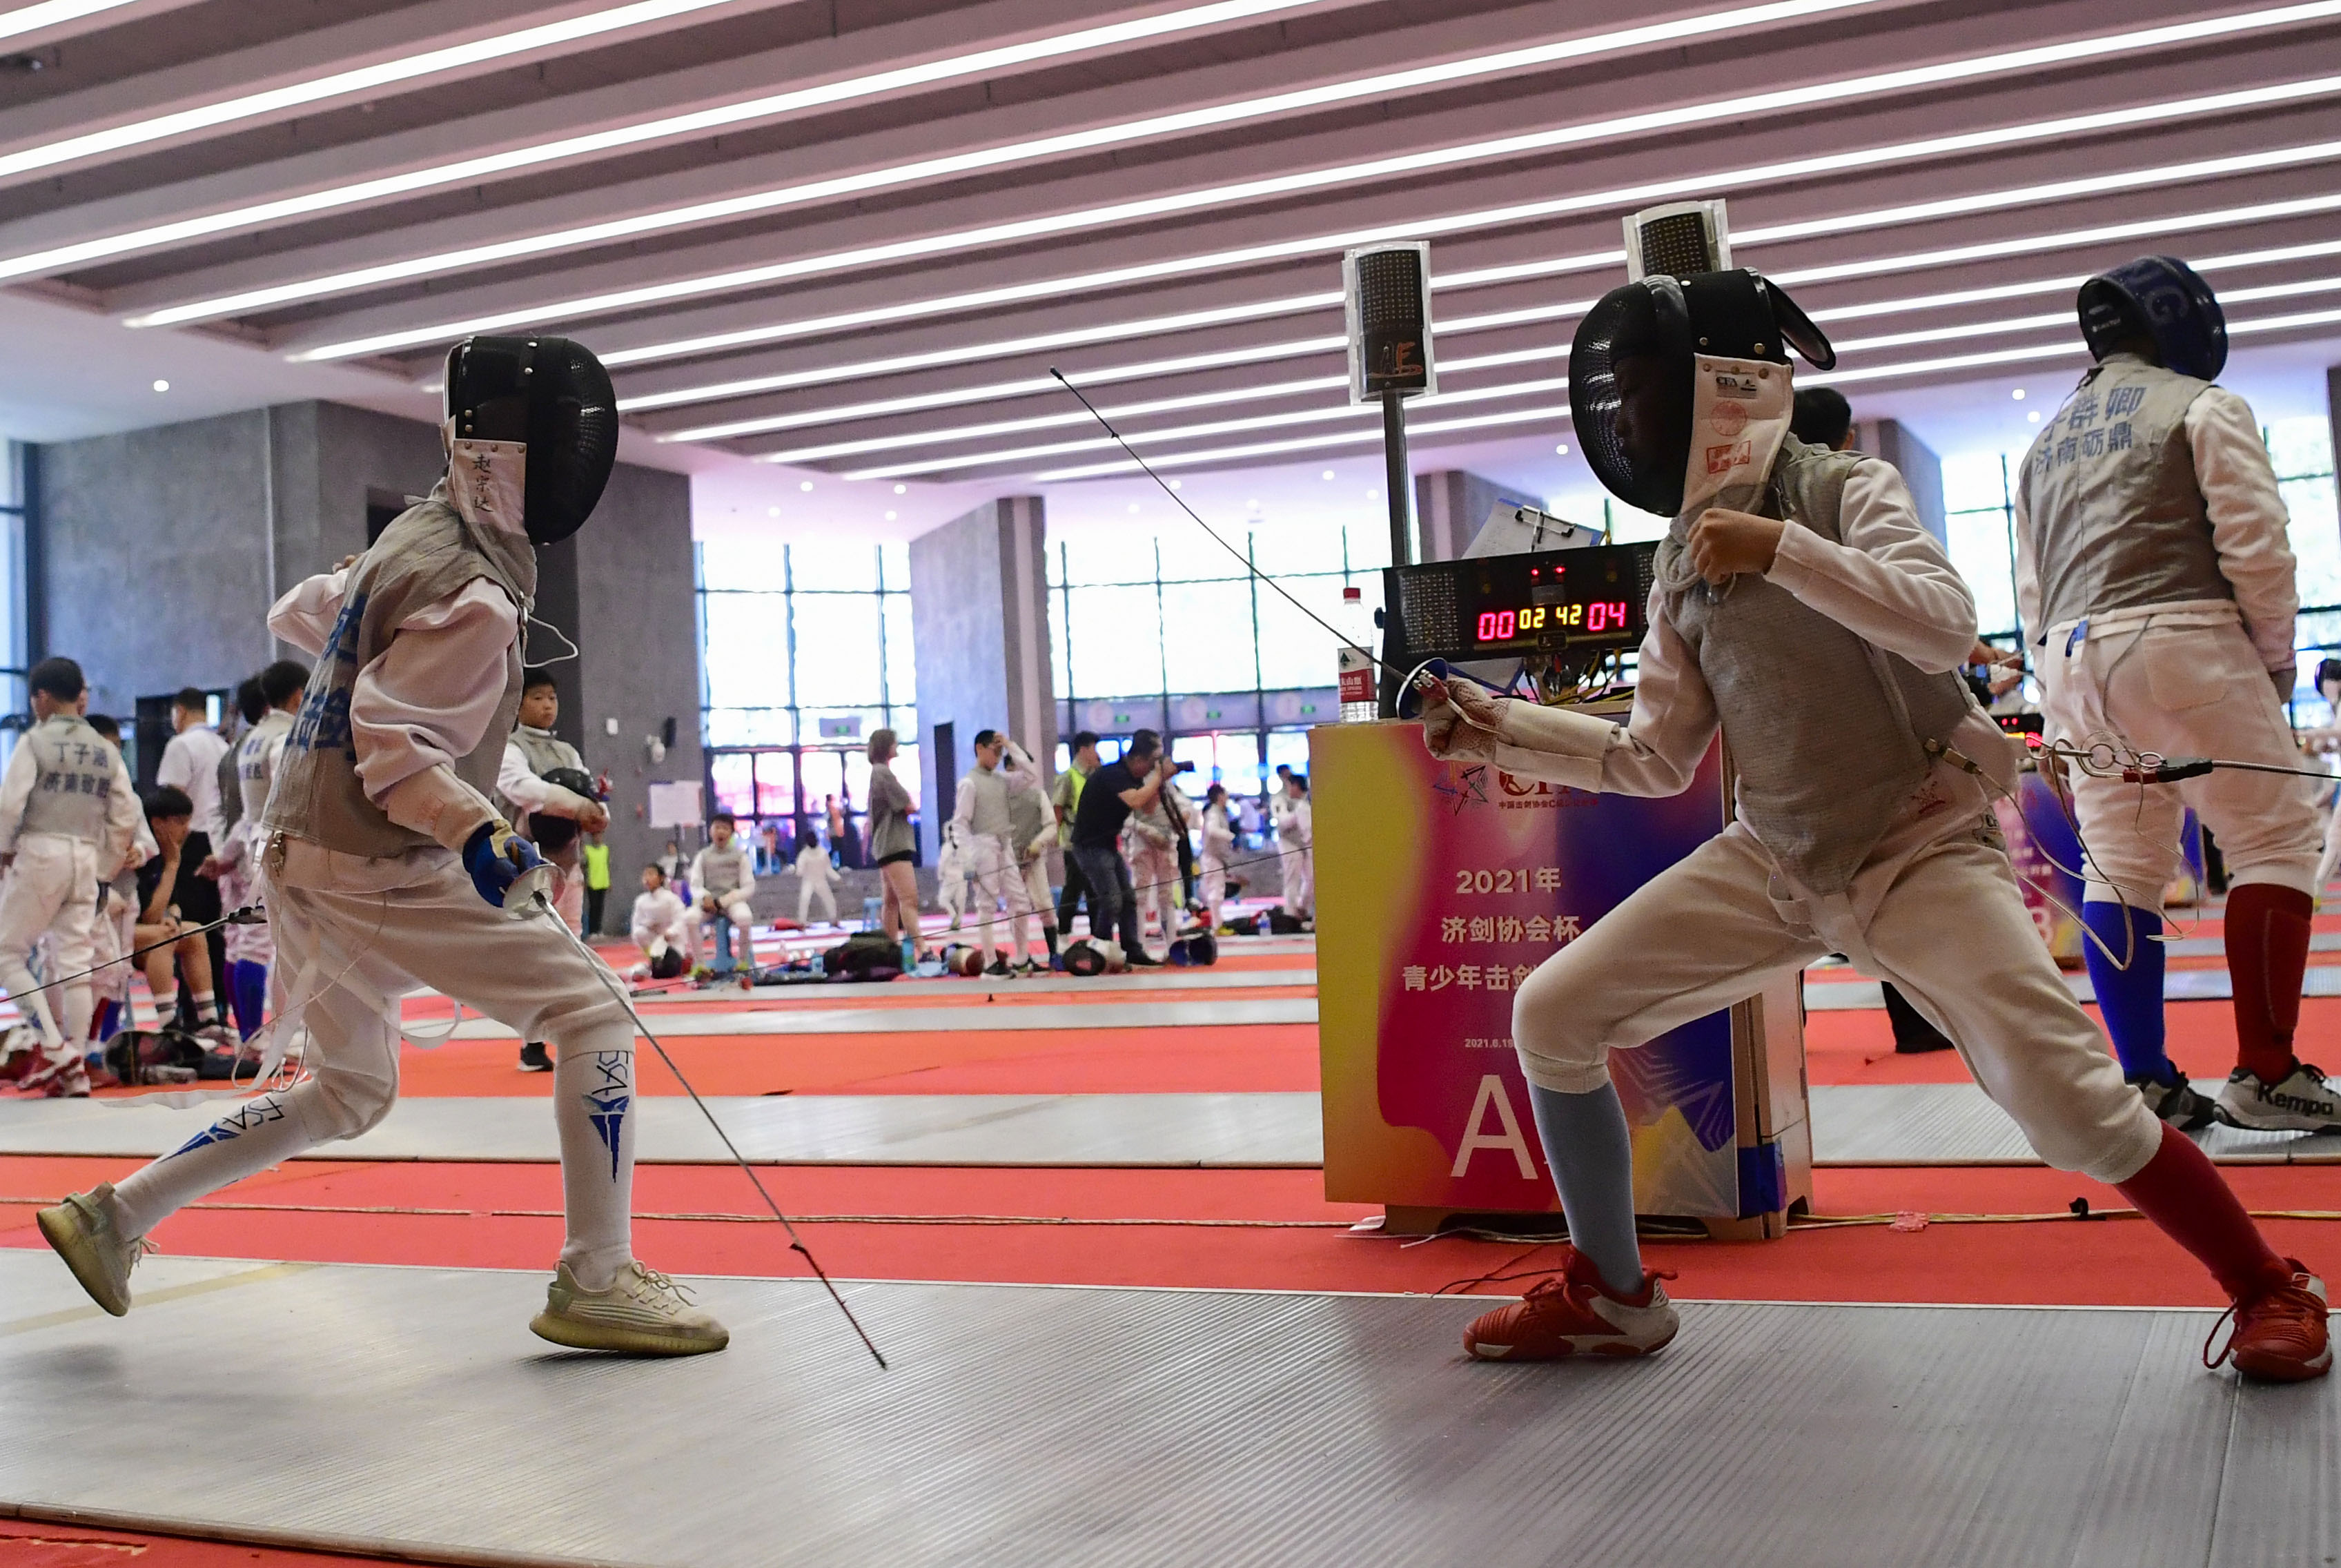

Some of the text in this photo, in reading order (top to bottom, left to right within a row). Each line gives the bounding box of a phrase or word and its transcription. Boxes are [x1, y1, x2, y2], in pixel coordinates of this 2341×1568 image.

[1477, 611, 1516, 641] 00
[1519, 607, 1546, 630] 02
[1556, 603, 1583, 626] 42
[1587, 602, 1627, 631] 04
[1456, 867, 1562, 894] 2021年
[1440, 914, 1581, 944] 济剑协会杯
